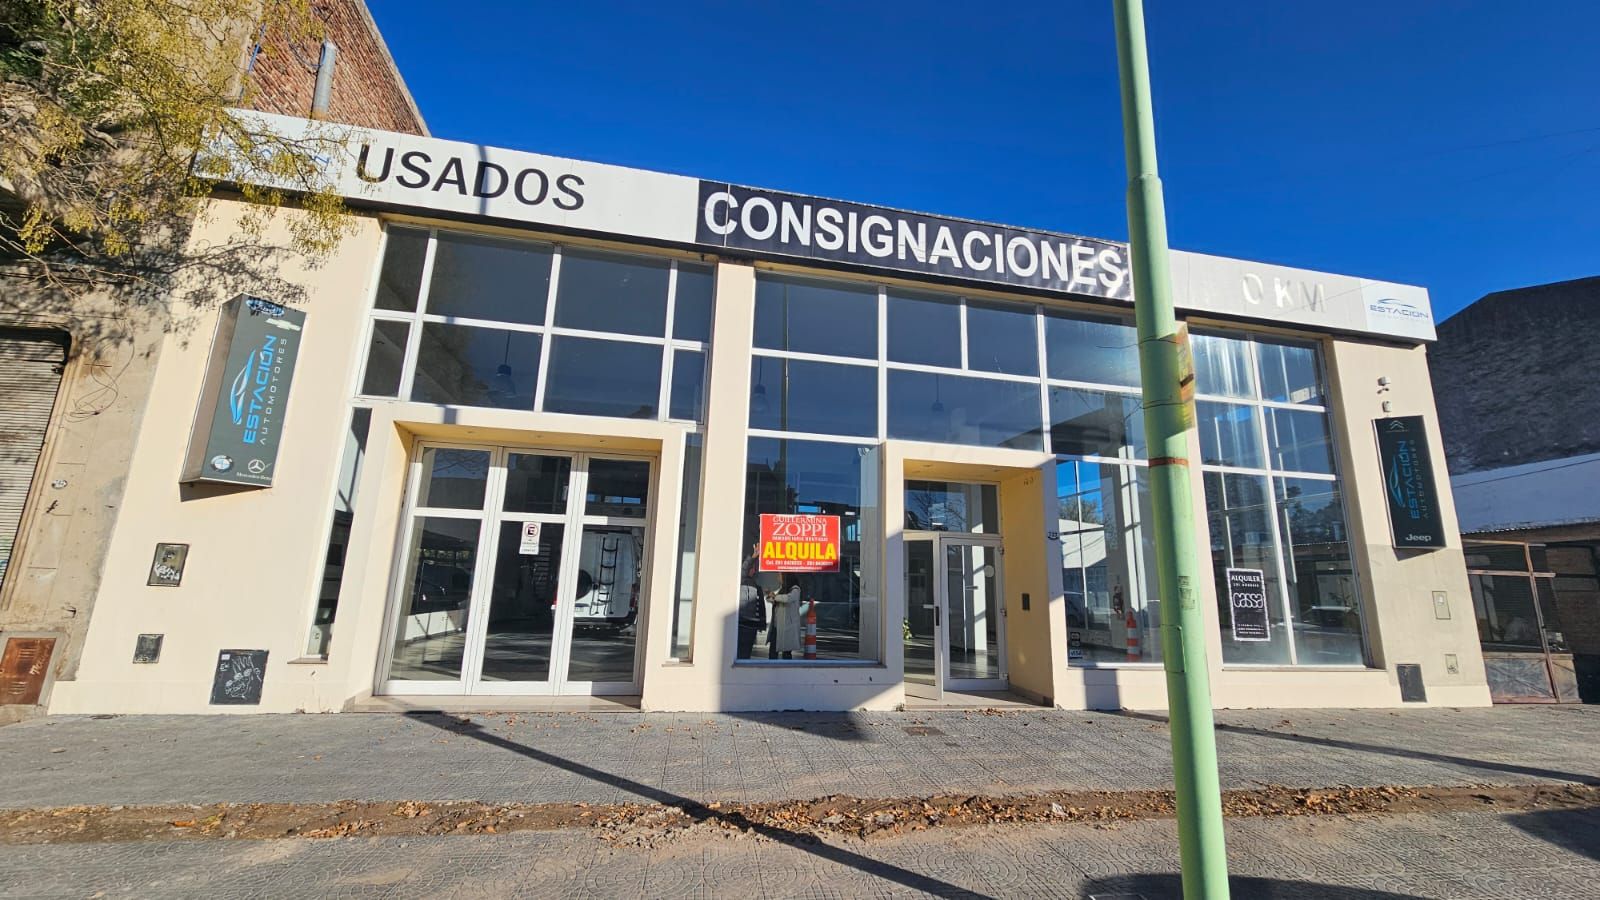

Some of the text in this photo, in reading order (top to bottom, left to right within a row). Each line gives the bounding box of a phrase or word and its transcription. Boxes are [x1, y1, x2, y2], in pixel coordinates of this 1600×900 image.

[356, 142, 585, 211] USADOS
[704, 191, 1124, 288] CONSIGNACIONES
[259, 338, 288, 445] AUTOMOTORES
[772, 515, 827, 524] GUILLERMINA
[772, 523, 827, 536] ZOPPI
[1405, 533, 1432, 542] Jeep
[763, 541, 837, 560] ALQUILA
[1231, 575, 1261, 583] ALQUILER
